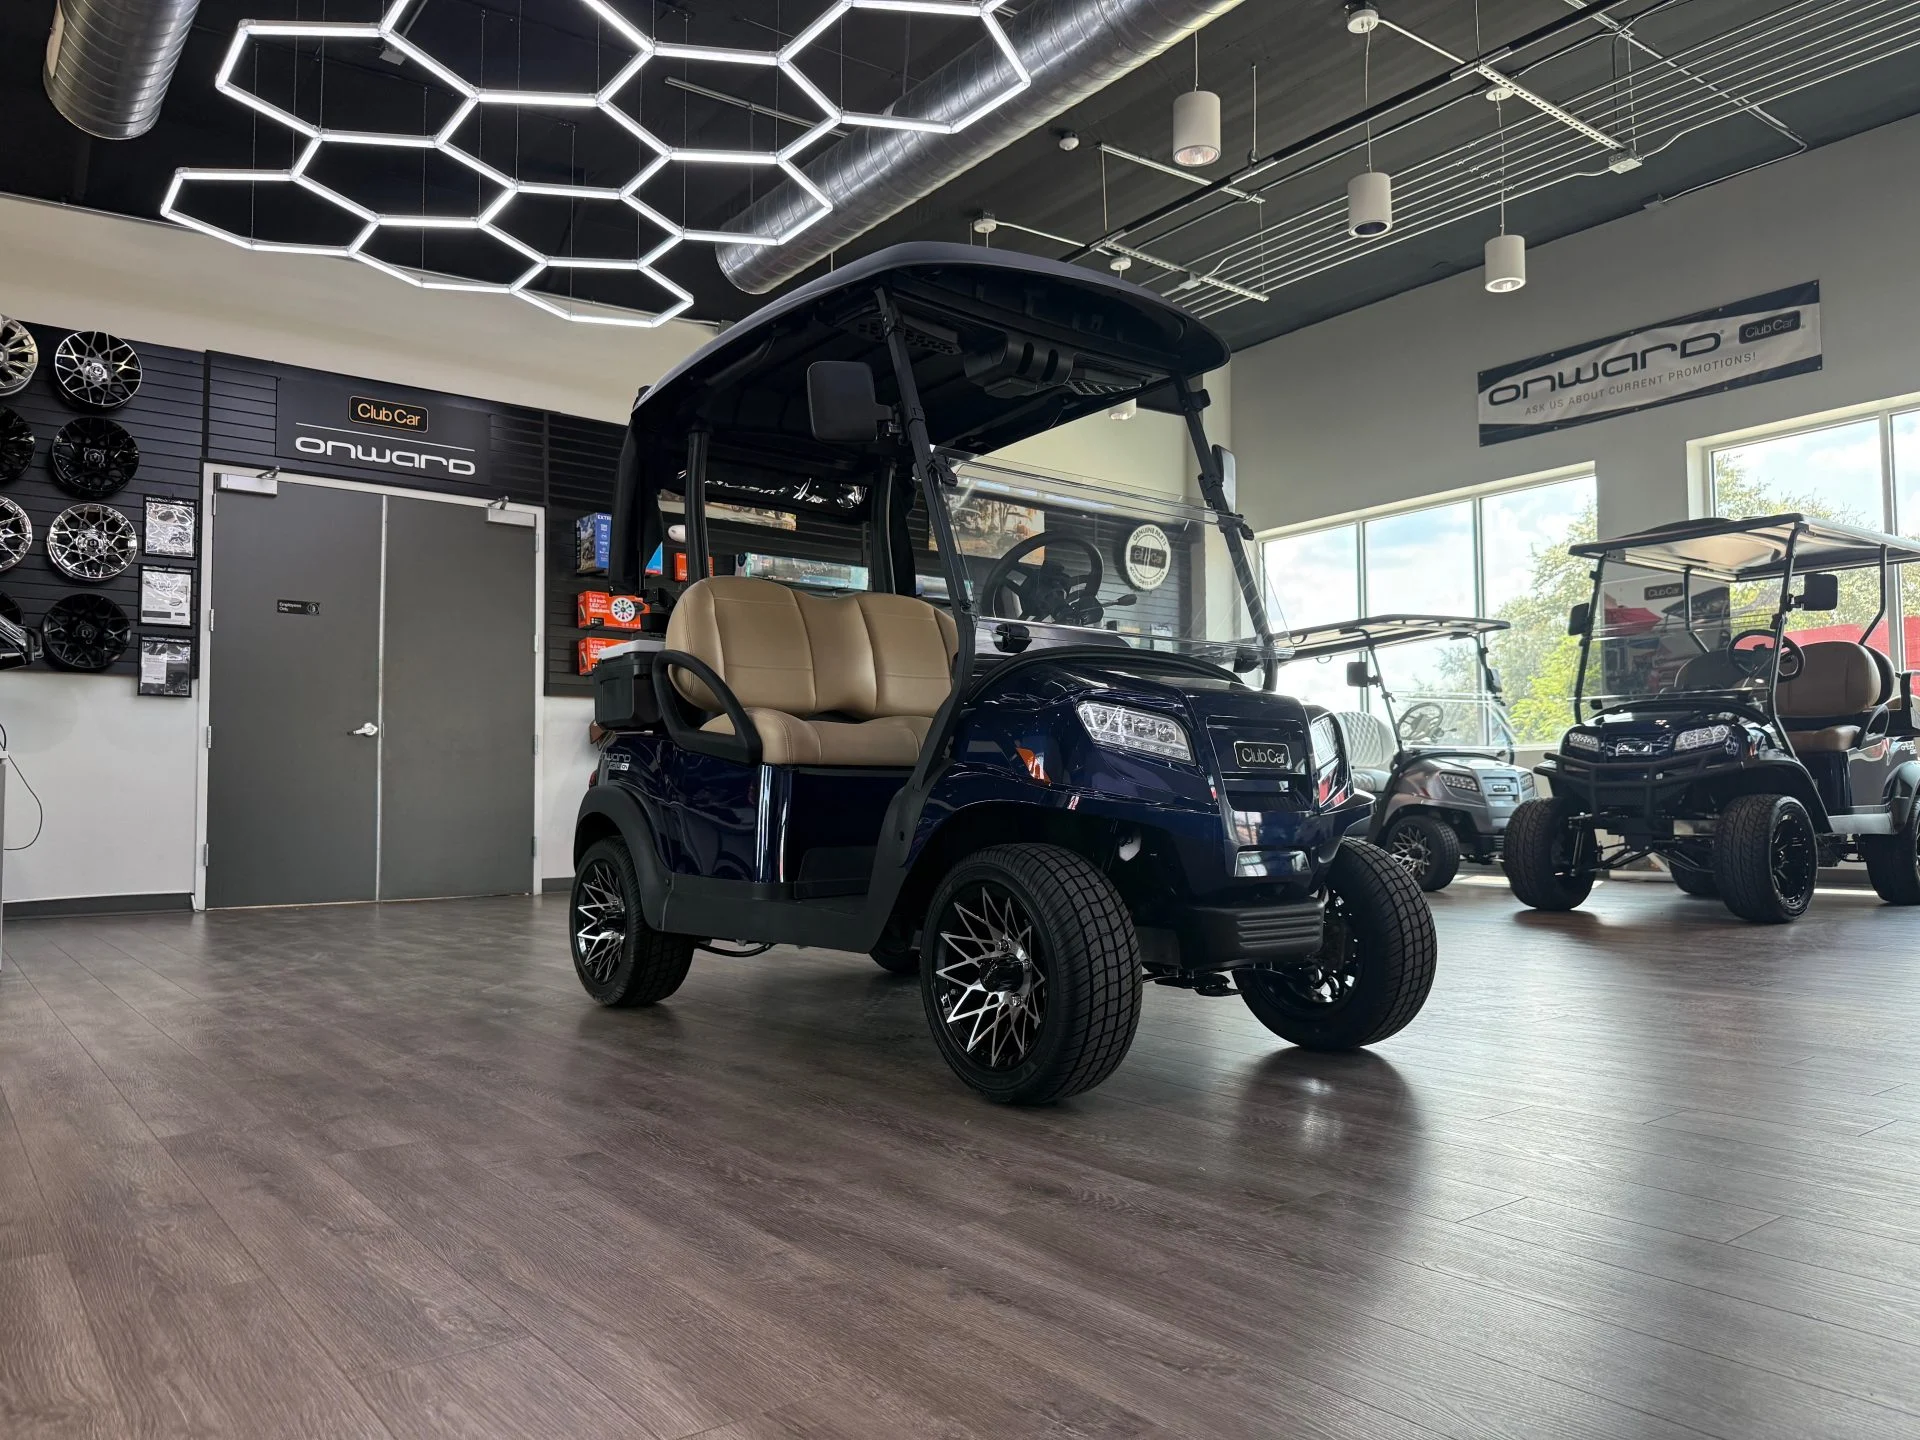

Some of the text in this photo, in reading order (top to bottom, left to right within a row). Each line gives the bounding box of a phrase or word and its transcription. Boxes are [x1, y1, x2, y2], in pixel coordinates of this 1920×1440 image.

[1745, 318, 1795, 338] Club Car
[1524, 351, 1756, 416] ASK US ABOUT CURRENT PROMOTIONS!
[357, 403, 421, 426] Club Car
[1241, 747, 1285, 764] Club Car
